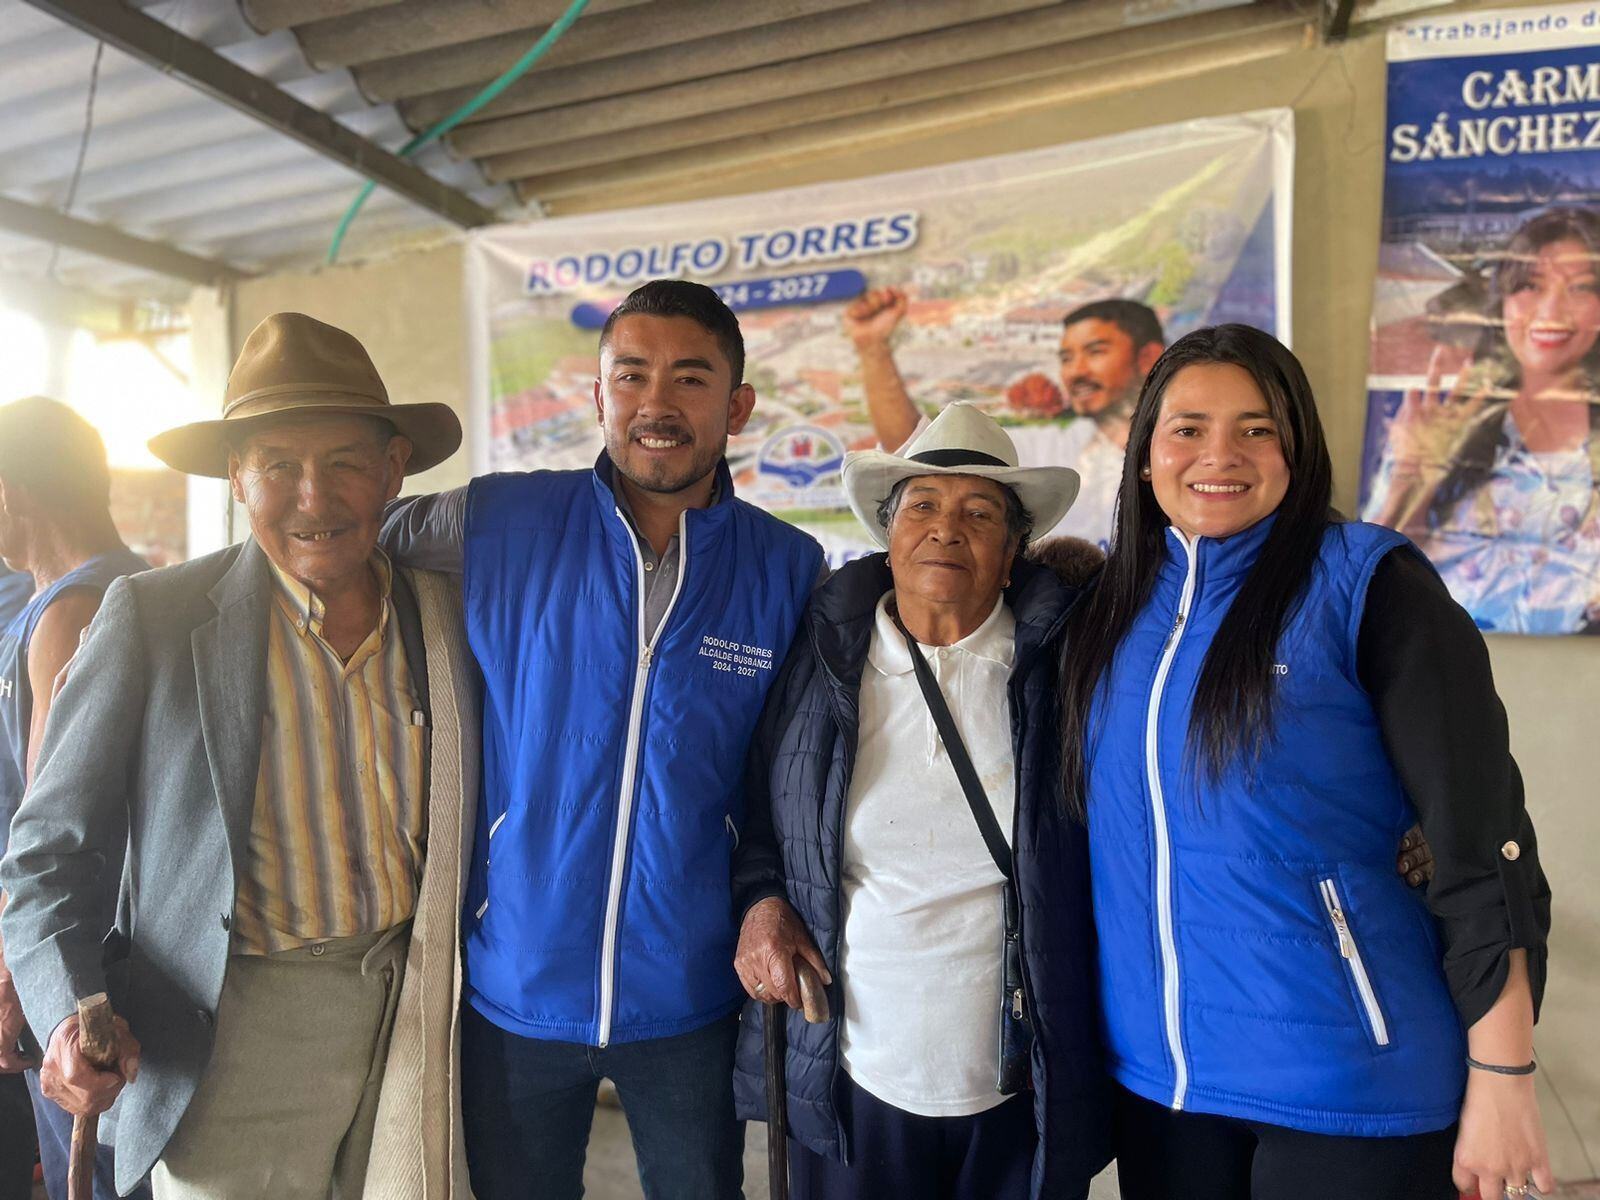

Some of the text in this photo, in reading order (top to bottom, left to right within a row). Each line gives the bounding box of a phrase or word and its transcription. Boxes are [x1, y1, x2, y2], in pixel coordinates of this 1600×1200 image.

[1461, 63, 1600, 110] CARM
[1390, 111, 1600, 162] SÁNCHEZ
[527, 213, 914, 290] RODOLFO TORRES
[713, 283, 750, 306] 24
[767, 273, 829, 302] 2027
[698, 646, 773, 671] ALCALDE BUSBANZA
[702, 635, 773, 659] RODOLFO TORRES
[712, 660, 732, 673] 2024
[737, 665, 757, 678] 2027
